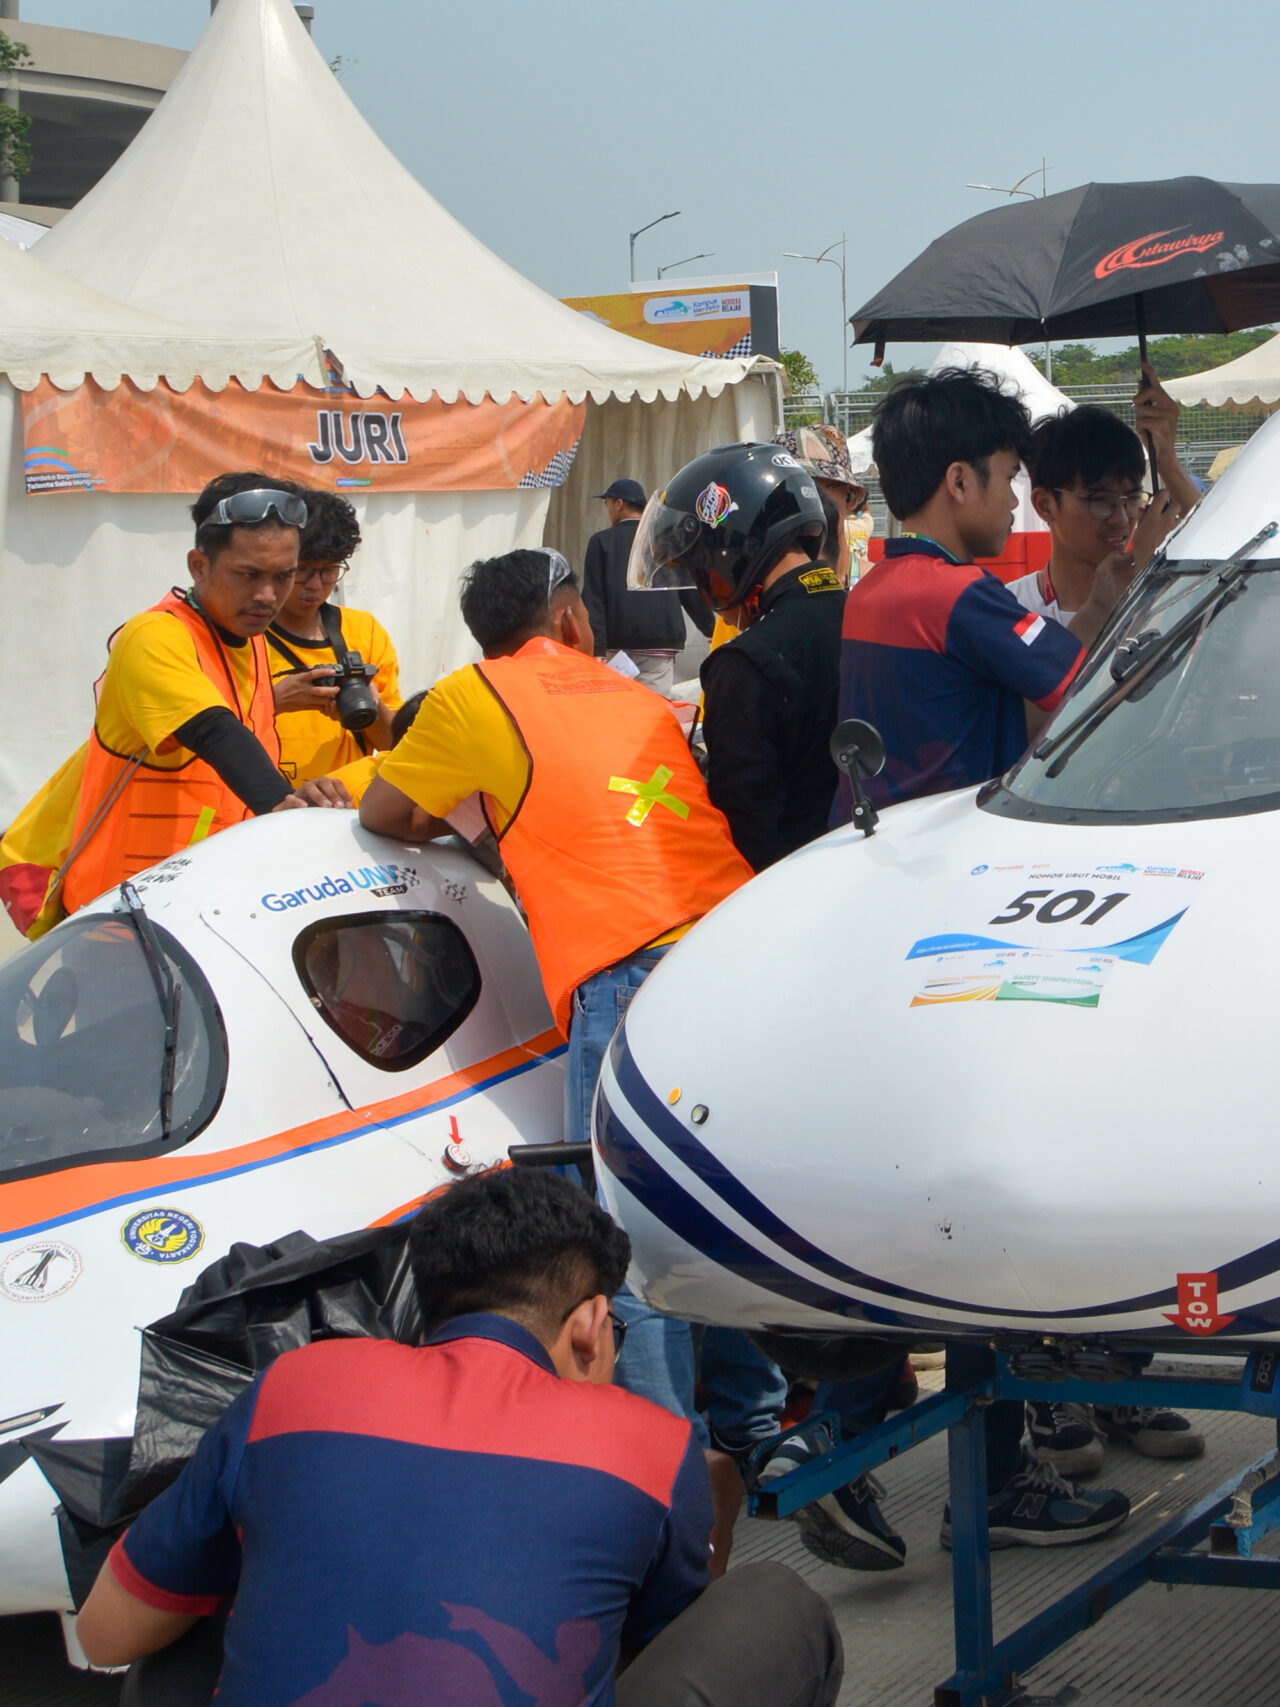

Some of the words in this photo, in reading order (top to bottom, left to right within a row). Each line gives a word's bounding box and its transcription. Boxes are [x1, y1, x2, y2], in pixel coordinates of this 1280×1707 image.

[306, 409, 409, 465] JURI
[377, 885, 405, 898] TEAM
[1028, 872, 1064, 880] NOMOR
[1065, 872, 1089, 880] URUT
[1091, 872, 1122, 880] MOBIL
[987, 889, 1132, 926] 501
[129, 1211, 165, 1240] UNIVERSITAS
[167, 1211, 194, 1230] NEGERI
[1185, 1282, 1213, 1328] TOW
